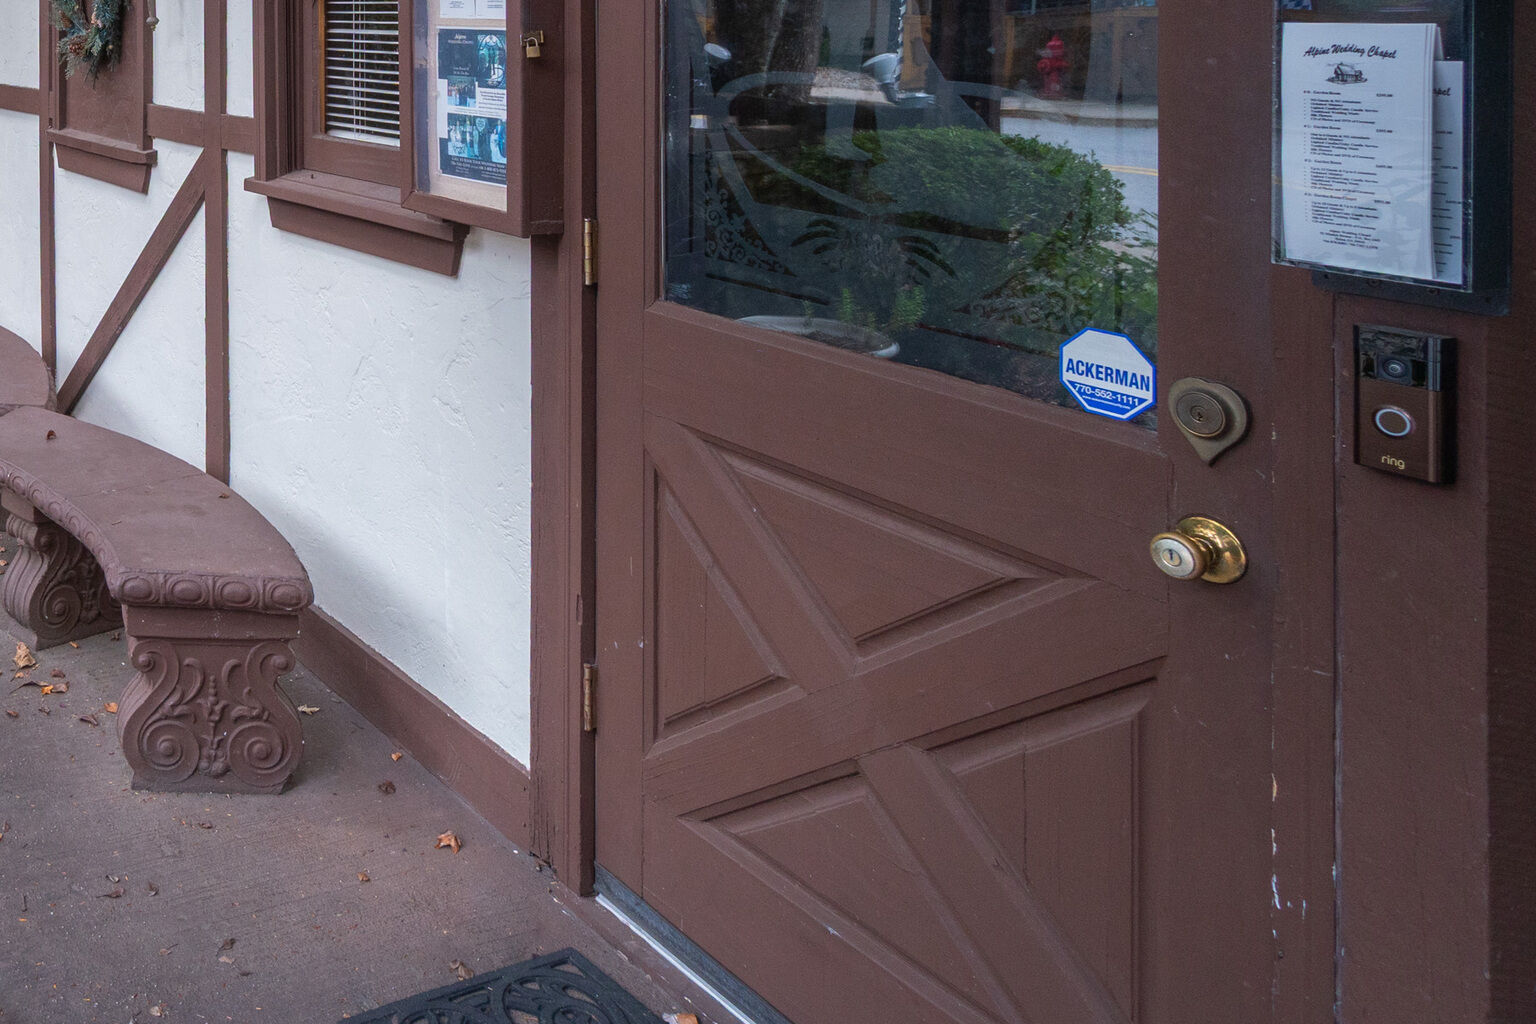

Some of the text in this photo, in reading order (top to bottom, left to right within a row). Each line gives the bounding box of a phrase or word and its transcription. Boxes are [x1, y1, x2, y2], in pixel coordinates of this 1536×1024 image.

[1303, 43, 1397, 59] Alpine Wedding Chapel
[1065, 358, 1150, 392] ACKERMAN
[1074, 383, 1139, 406] 770-552-1111
[1381, 454, 1405, 470] ring
